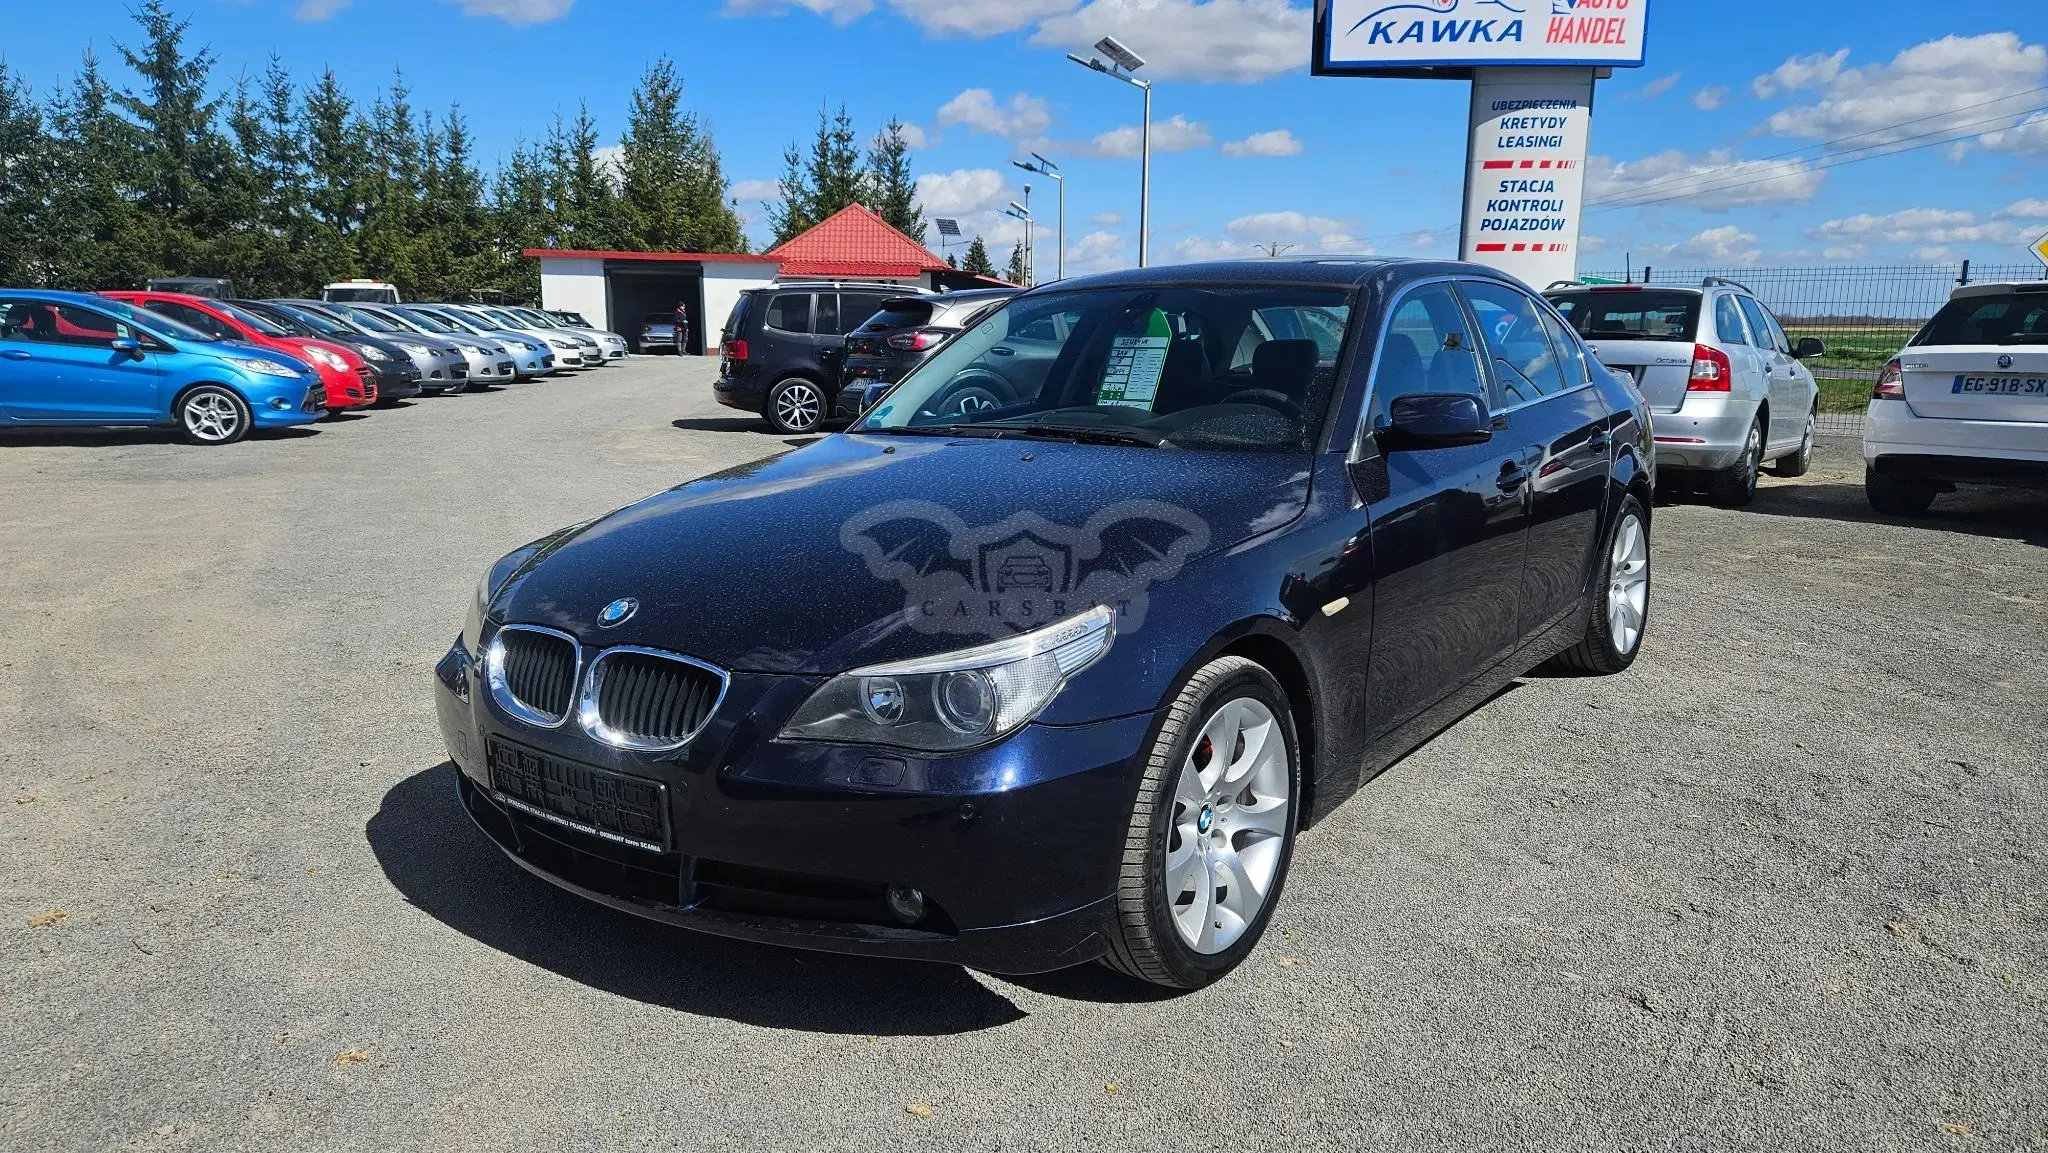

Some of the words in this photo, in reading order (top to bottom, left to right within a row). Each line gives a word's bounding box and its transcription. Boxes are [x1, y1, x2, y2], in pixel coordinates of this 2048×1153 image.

[1368, 19, 1523, 44] KAWKA
[1546, 16, 1626, 44] HANDEL
[1492, 99, 1577, 111] UBEZPIECZENIA
[1500, 117, 1568, 129] KRETYDY
[1497, 135, 1563, 148] LEASINGI
[1499, 180, 1554, 193] STACJA
[1486, 199, 1564, 212] KONTROLI
[1480, 215, 1566, 231] POJAZDÓW
[1964, 377, 2047, 393] EG-918-SX
